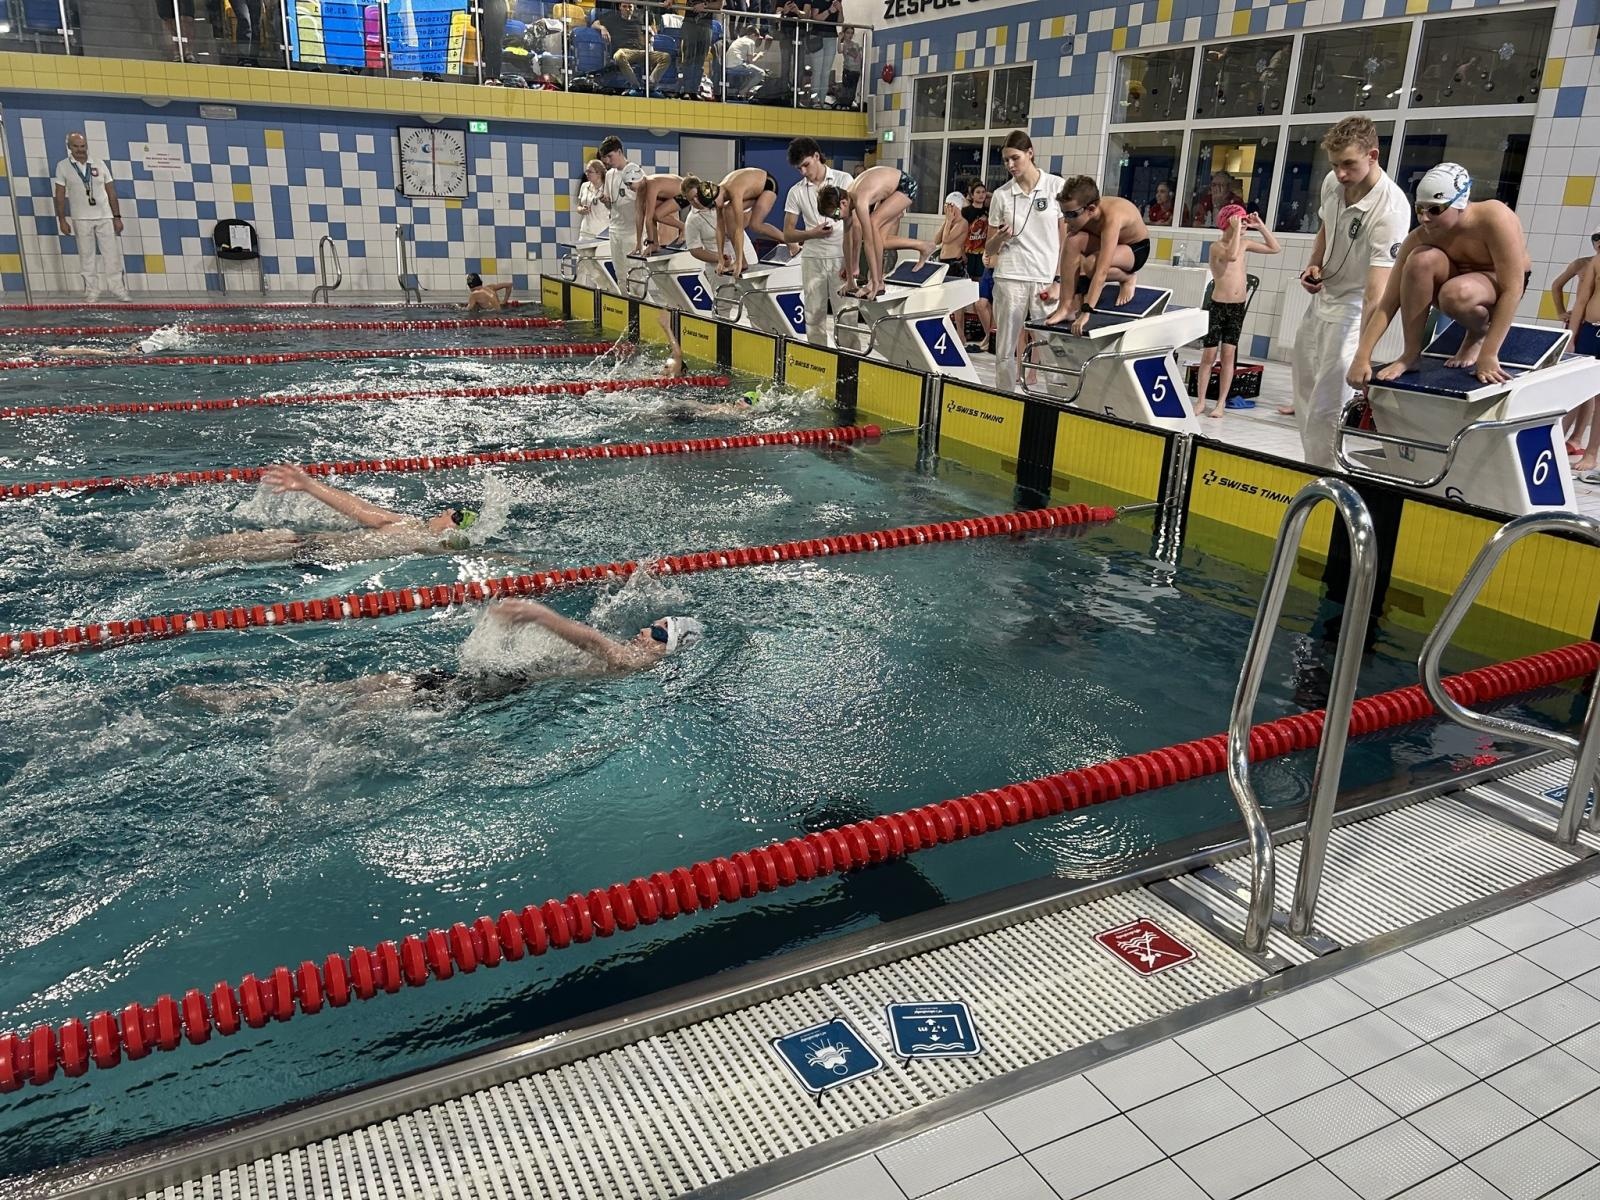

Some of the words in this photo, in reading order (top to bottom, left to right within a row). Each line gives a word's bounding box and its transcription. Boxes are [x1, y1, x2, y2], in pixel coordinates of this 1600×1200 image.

[692, 285, 704, 301] 2
[793, 305, 804, 324] 3
[934, 332, 947, 355] 4
[1151, 375, 1168, 402] 5
[955, 405, 979, 417] SWISS
[979, 411, 1005, 424] TIMING
[1532, 449, 1552, 486] 6
[1218, 477, 1259, 495] SWISS
[1259, 488, 1295, 505] TIMIN
